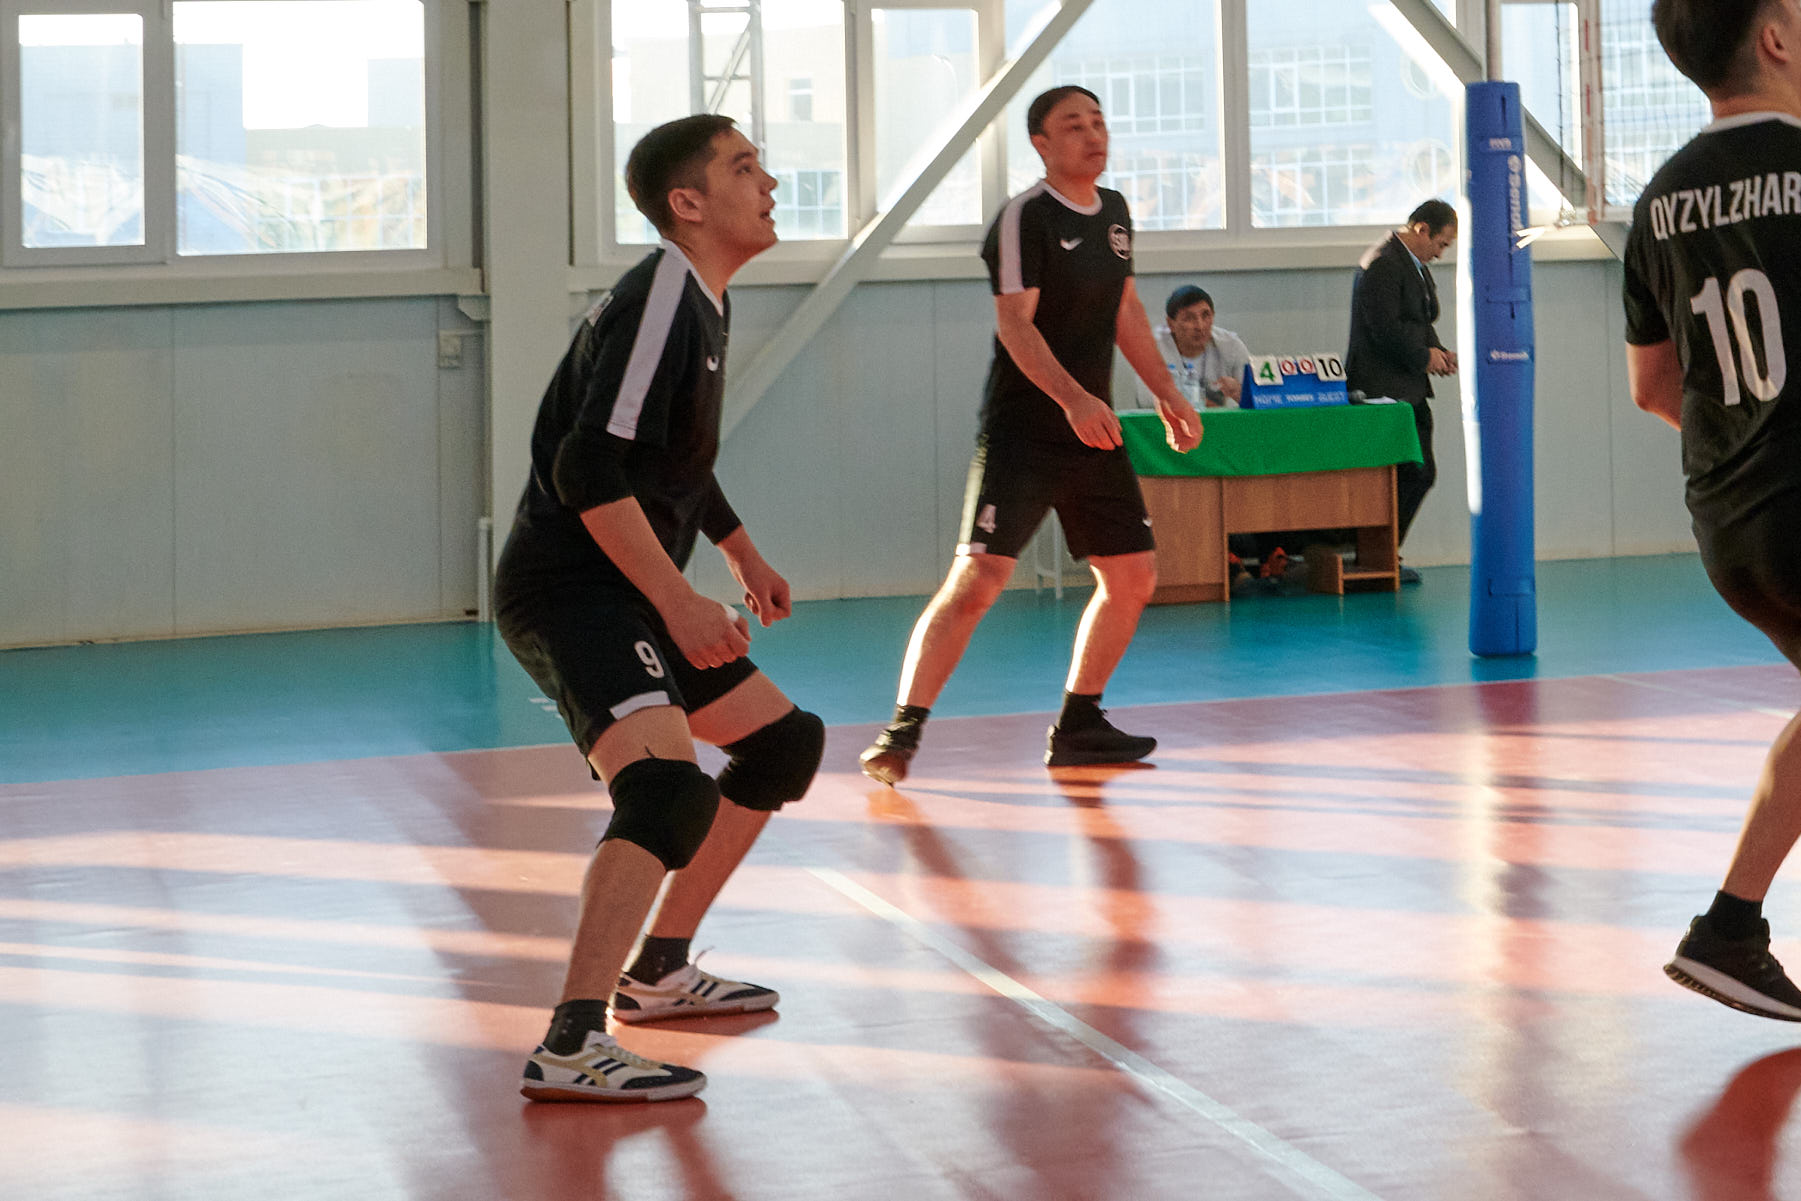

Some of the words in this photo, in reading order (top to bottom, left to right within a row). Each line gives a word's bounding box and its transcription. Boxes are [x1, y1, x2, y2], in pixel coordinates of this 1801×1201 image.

[1690, 268, 1787, 406] 10
[1260, 361, 1275, 382] 4
[1318, 358, 1342, 377] 10
[634, 640, 665, 678] 9
